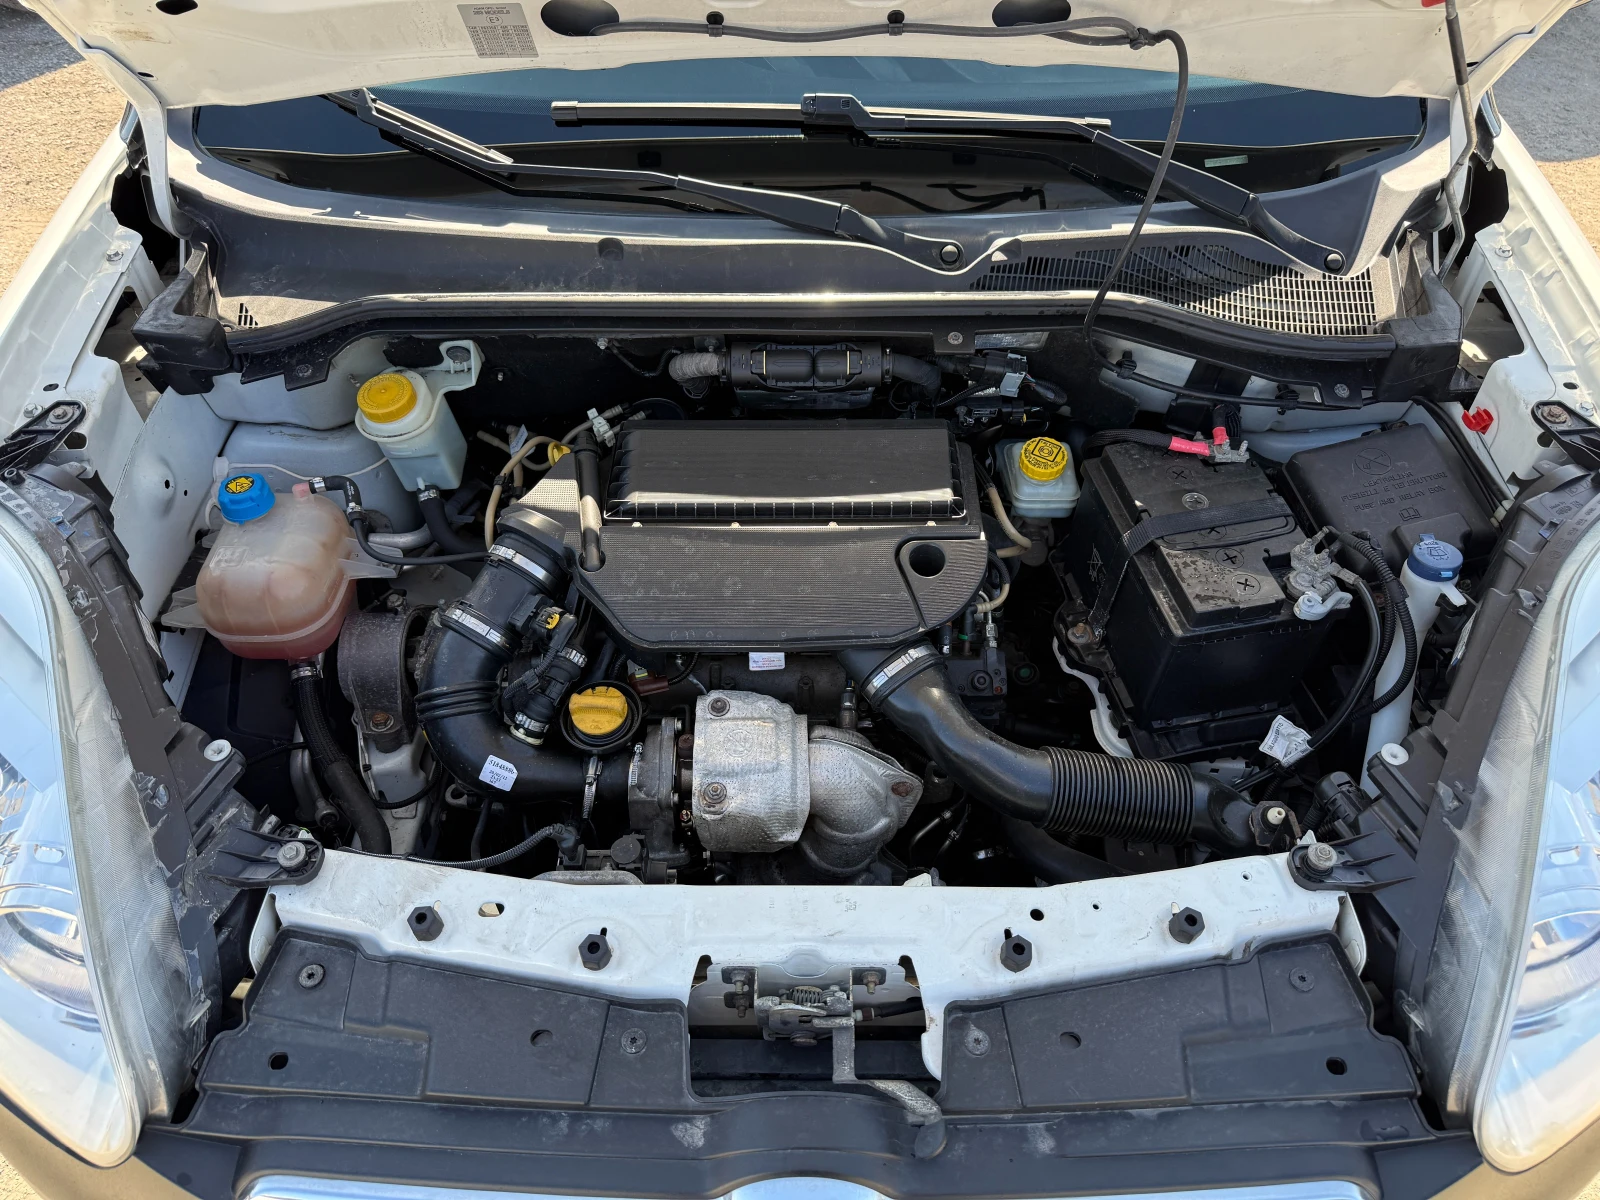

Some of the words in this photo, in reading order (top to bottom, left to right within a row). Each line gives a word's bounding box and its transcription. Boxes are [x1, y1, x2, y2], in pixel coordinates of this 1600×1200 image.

[1341, 488, 1379, 503] FUSIBILI
[1383, 485, 1390, 493] E
[1354, 502, 1375, 512] FUSE
[1380, 497, 1395, 507] AND
[1399, 491, 1425, 502] RELAY
[1428, 485, 1446, 494] BOX
